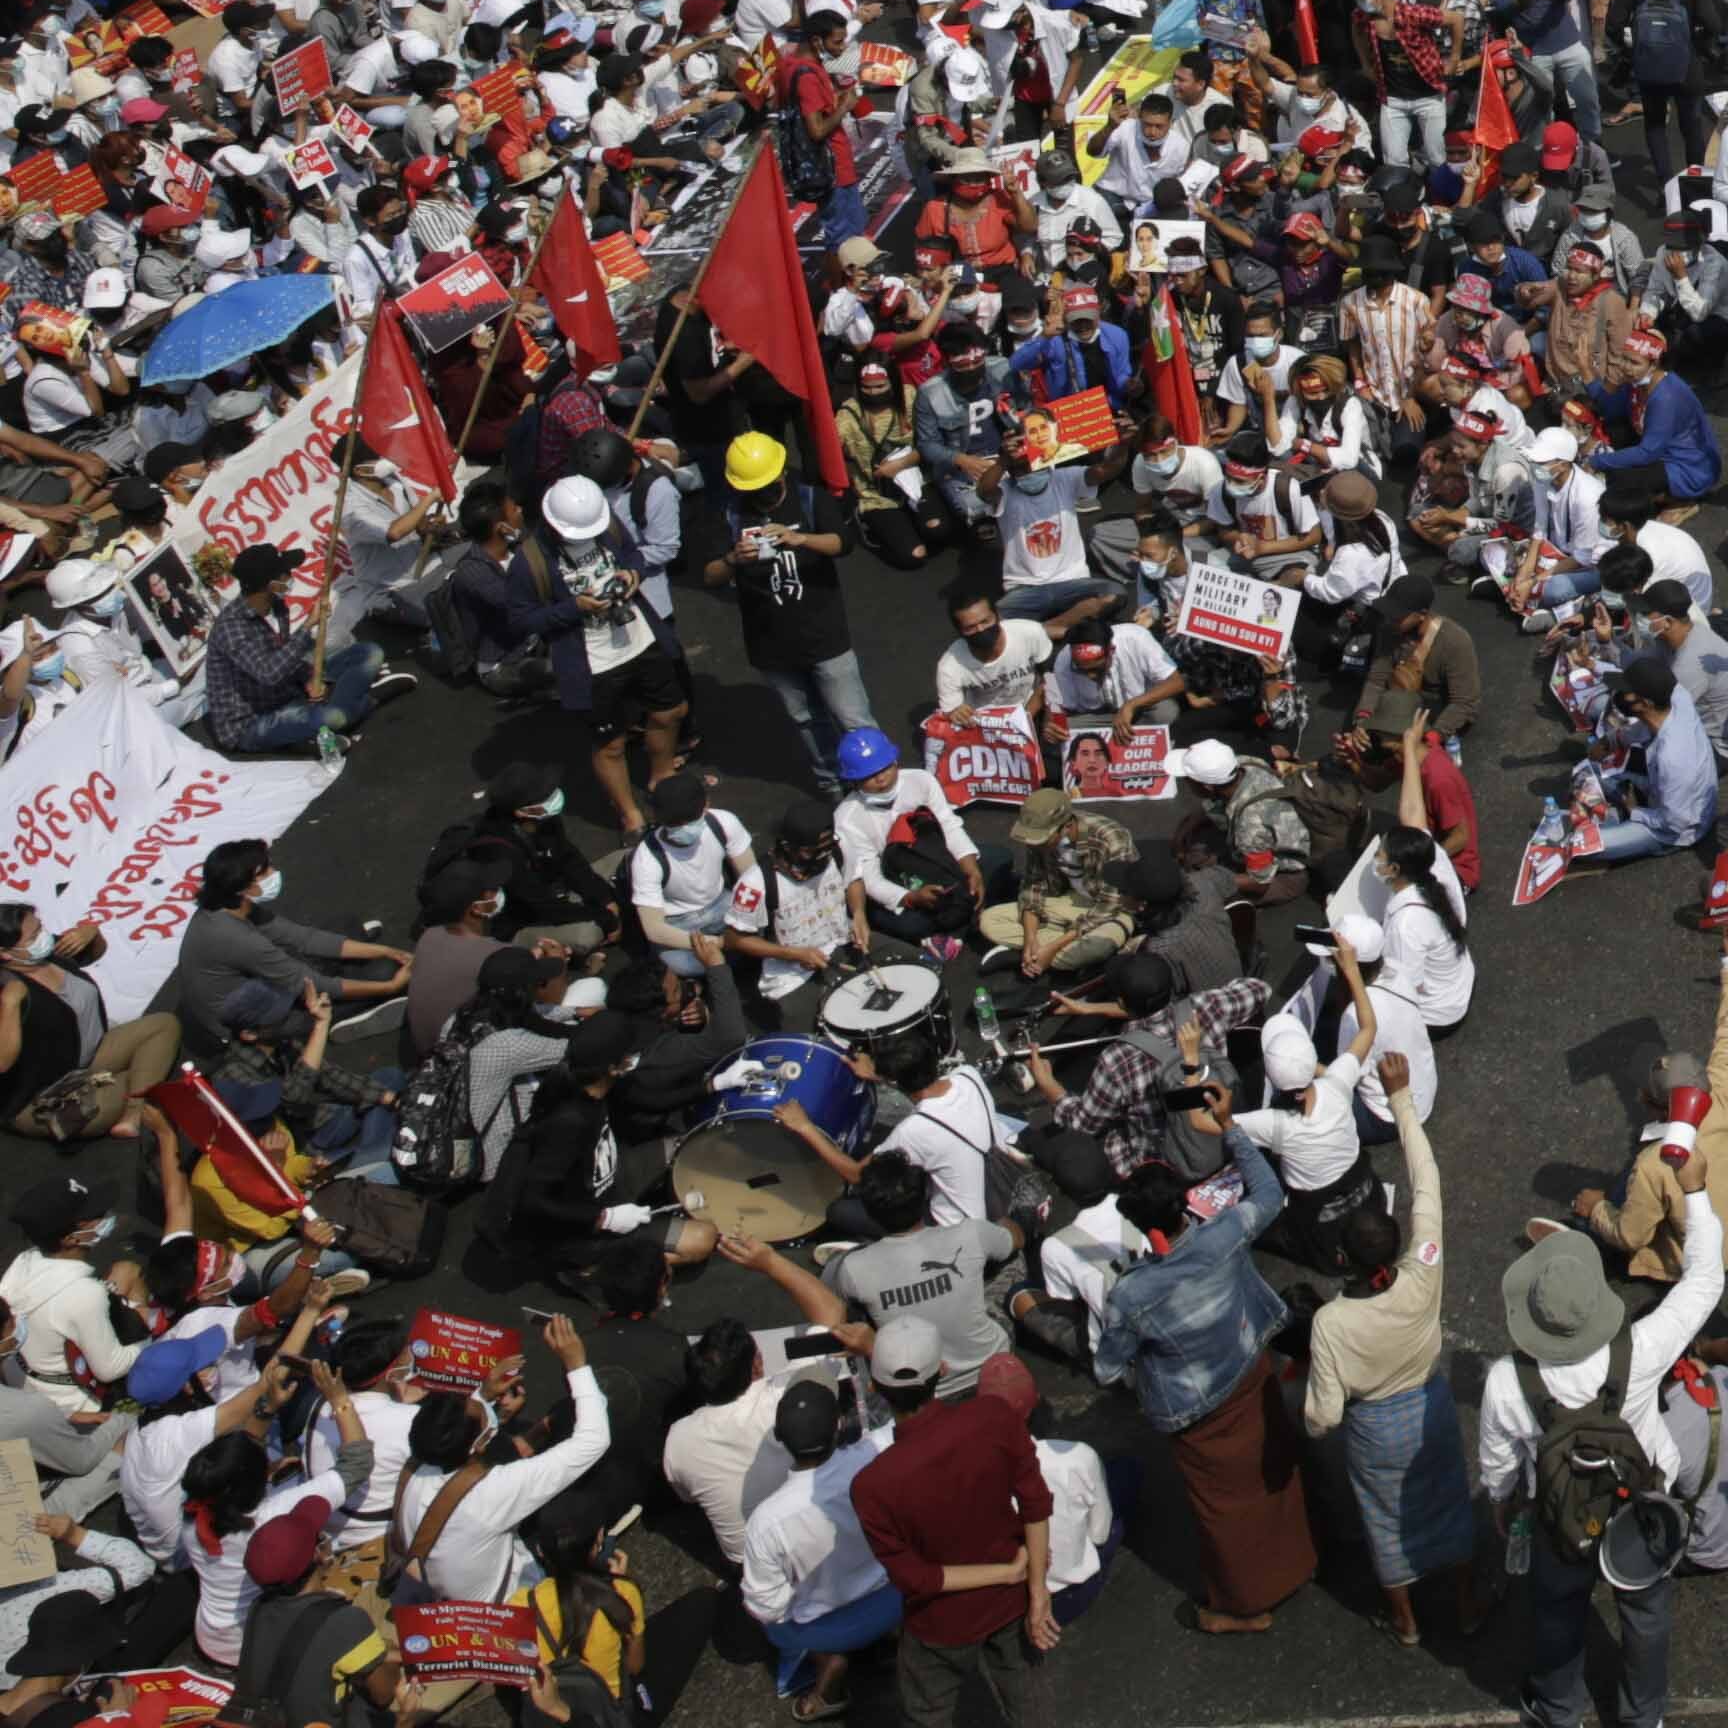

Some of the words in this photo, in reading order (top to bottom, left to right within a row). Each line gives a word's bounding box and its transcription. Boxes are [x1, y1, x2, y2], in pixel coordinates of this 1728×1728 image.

[457, 273, 490, 297] CDM
[968, 398, 993, 436] P
[1197, 568, 1230, 588] FORCE
[1232, 579, 1252, 594] THE
[1192, 596, 1202, 606] TO
[1204, 599, 1239, 616] RELEASE
[1194, 584, 1248, 608] MILITARY
[1192, 616, 1216, 632] AUNG
[1217, 622, 1238, 637] SAN
[1257, 633, 1276, 647] KYI
[1129, 733, 1156, 747] REE
[948, 744, 1031, 783] CDM
[1123, 747, 1153, 760] OUR
[1107, 759, 1164, 773] LEADERS
[879, 1273, 953, 1311] PUMA
[431, 1314, 443, 1324] We
[444, 1316, 479, 1333] Myanmar
[479, 1325, 504, 1339] People
[430, 1344, 451, 1360] UN
[457, 1352, 471, 1365] &
[478, 1354, 498, 1368] US
[415, 1367, 454, 1383] Terrorist
[419, 1607, 437, 1616] We
[438, 1605, 485, 1616] Myanmar
[485, 1607, 515, 1619] People
[430, 1633, 459, 1649] UN
[469, 1633, 485, 1646] &
[493, 1637, 516, 1651] US
[416, 1660, 470, 1672] Terrorist
[472, 1660, 537, 1676] Dictatorship
